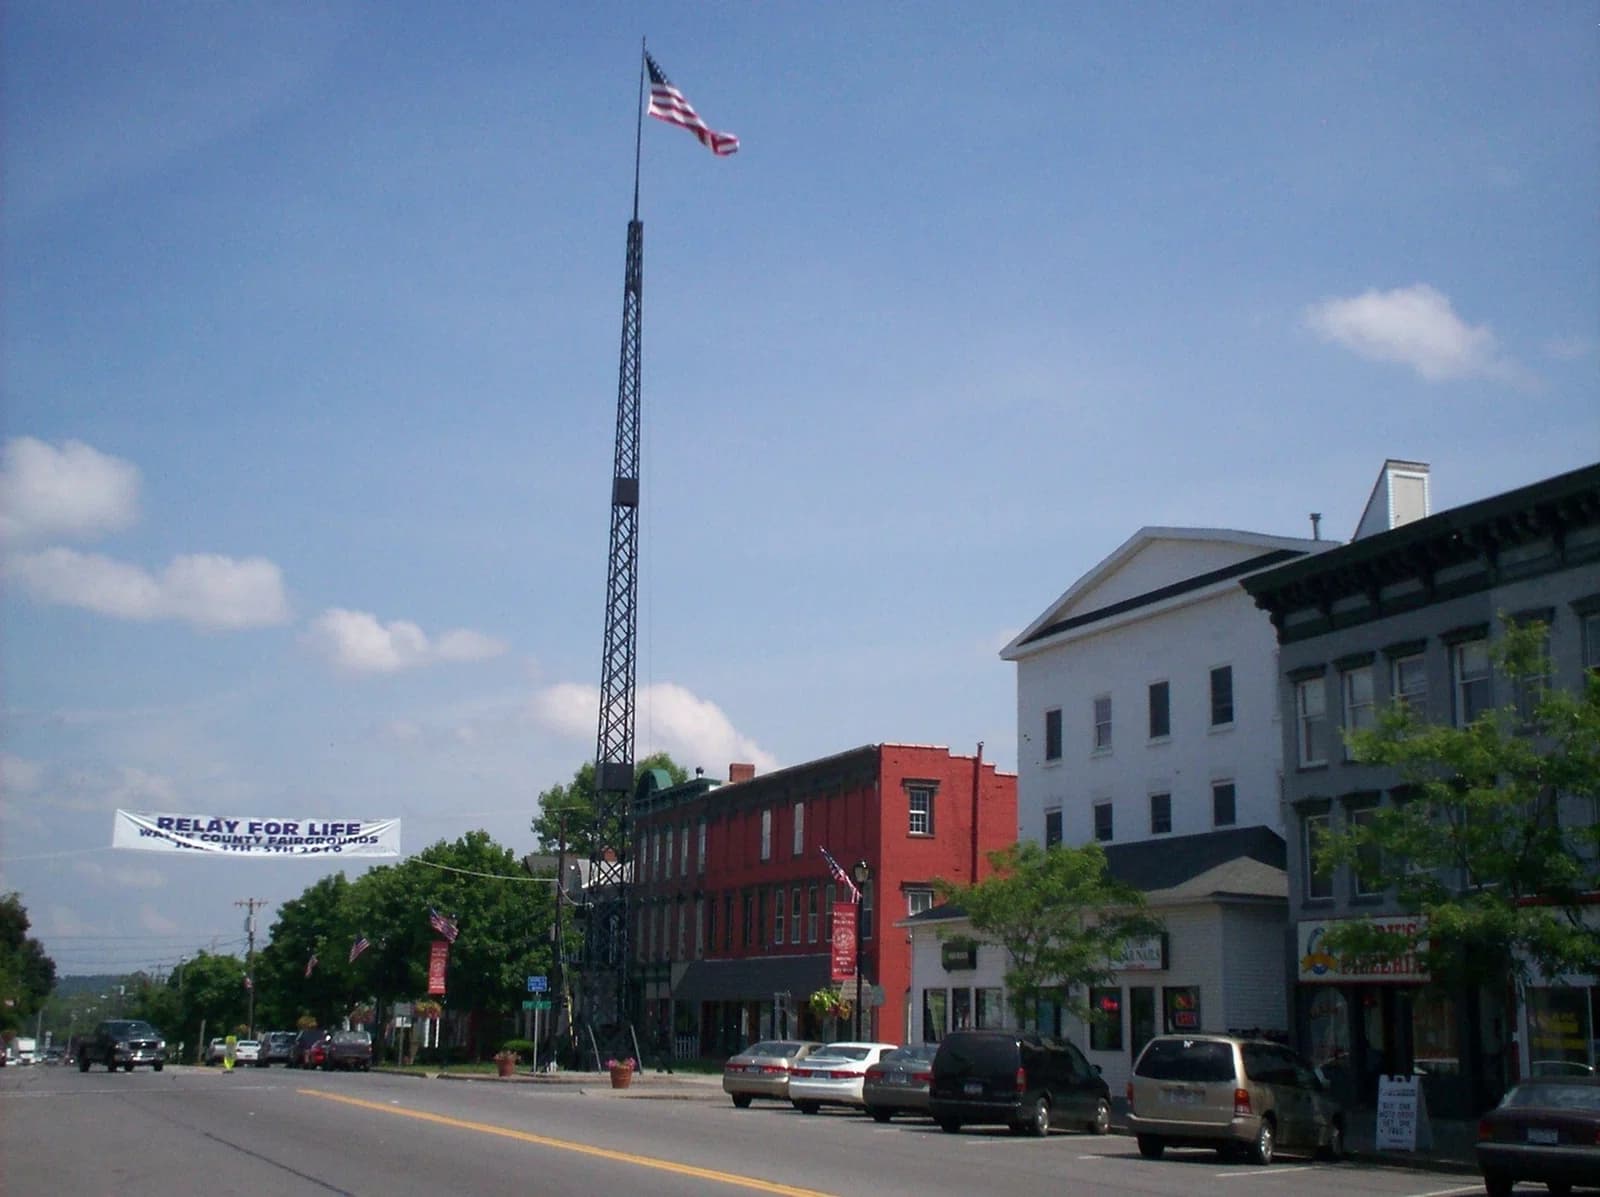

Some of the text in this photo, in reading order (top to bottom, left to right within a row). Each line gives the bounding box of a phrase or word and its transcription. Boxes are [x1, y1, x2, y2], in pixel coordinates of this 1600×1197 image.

[157, 817, 361, 837] RELAY FOR LIFE
[200, 833, 263, 845] COUNTY
[268, 835, 379, 846] FAIRGROUNDS
